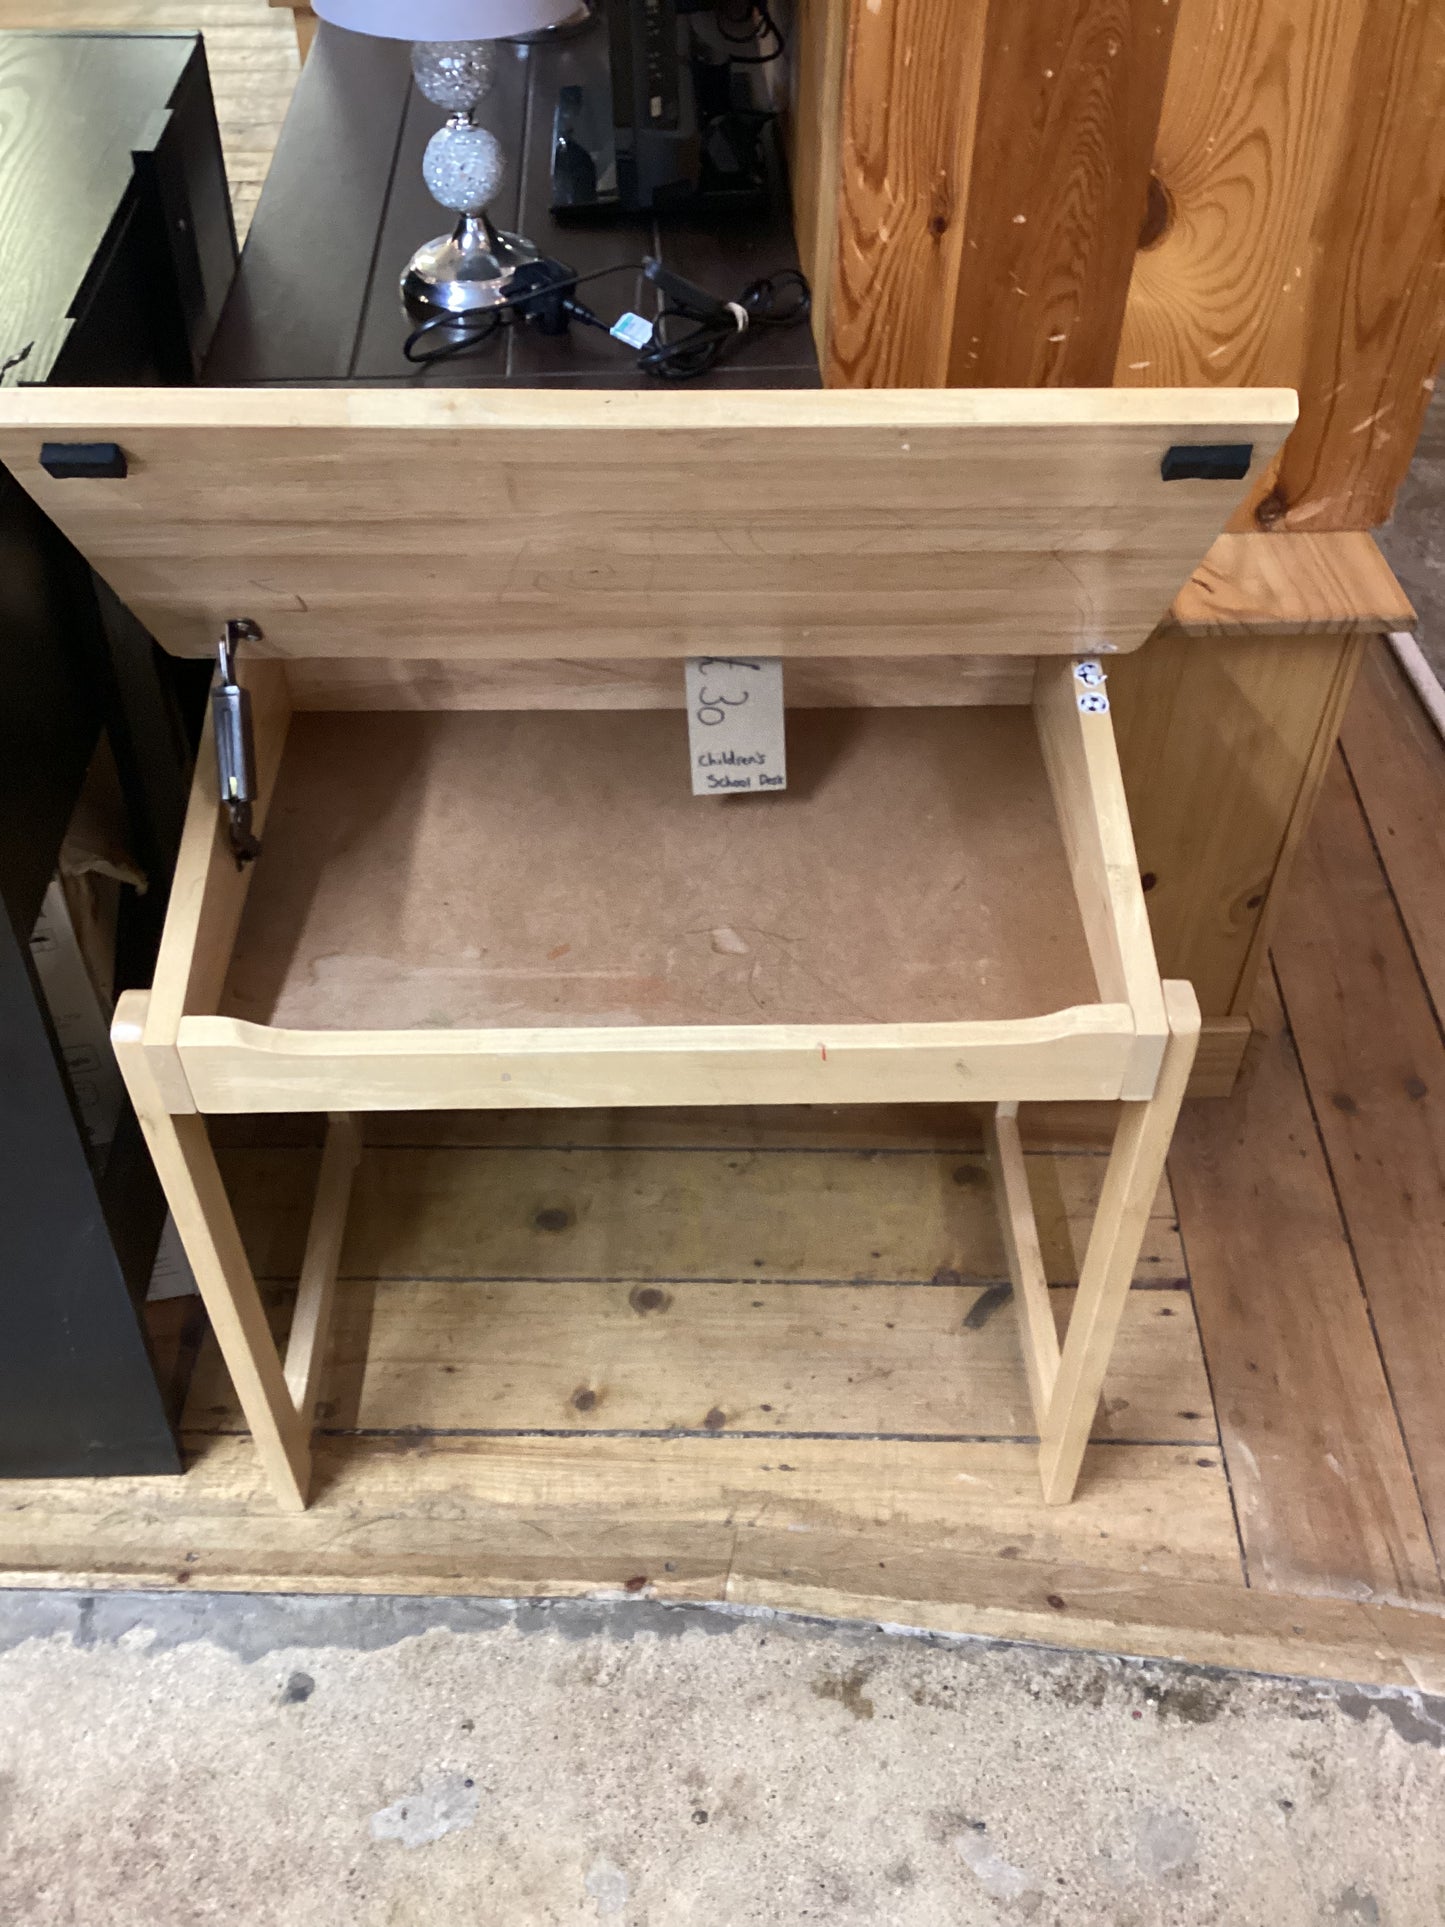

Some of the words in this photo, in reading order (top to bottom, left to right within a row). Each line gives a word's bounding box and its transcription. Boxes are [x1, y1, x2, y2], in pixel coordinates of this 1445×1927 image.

[698, 750, 766, 767] Children's
[706, 774, 751, 788] School
[759, 773, 784, 786] Desk
